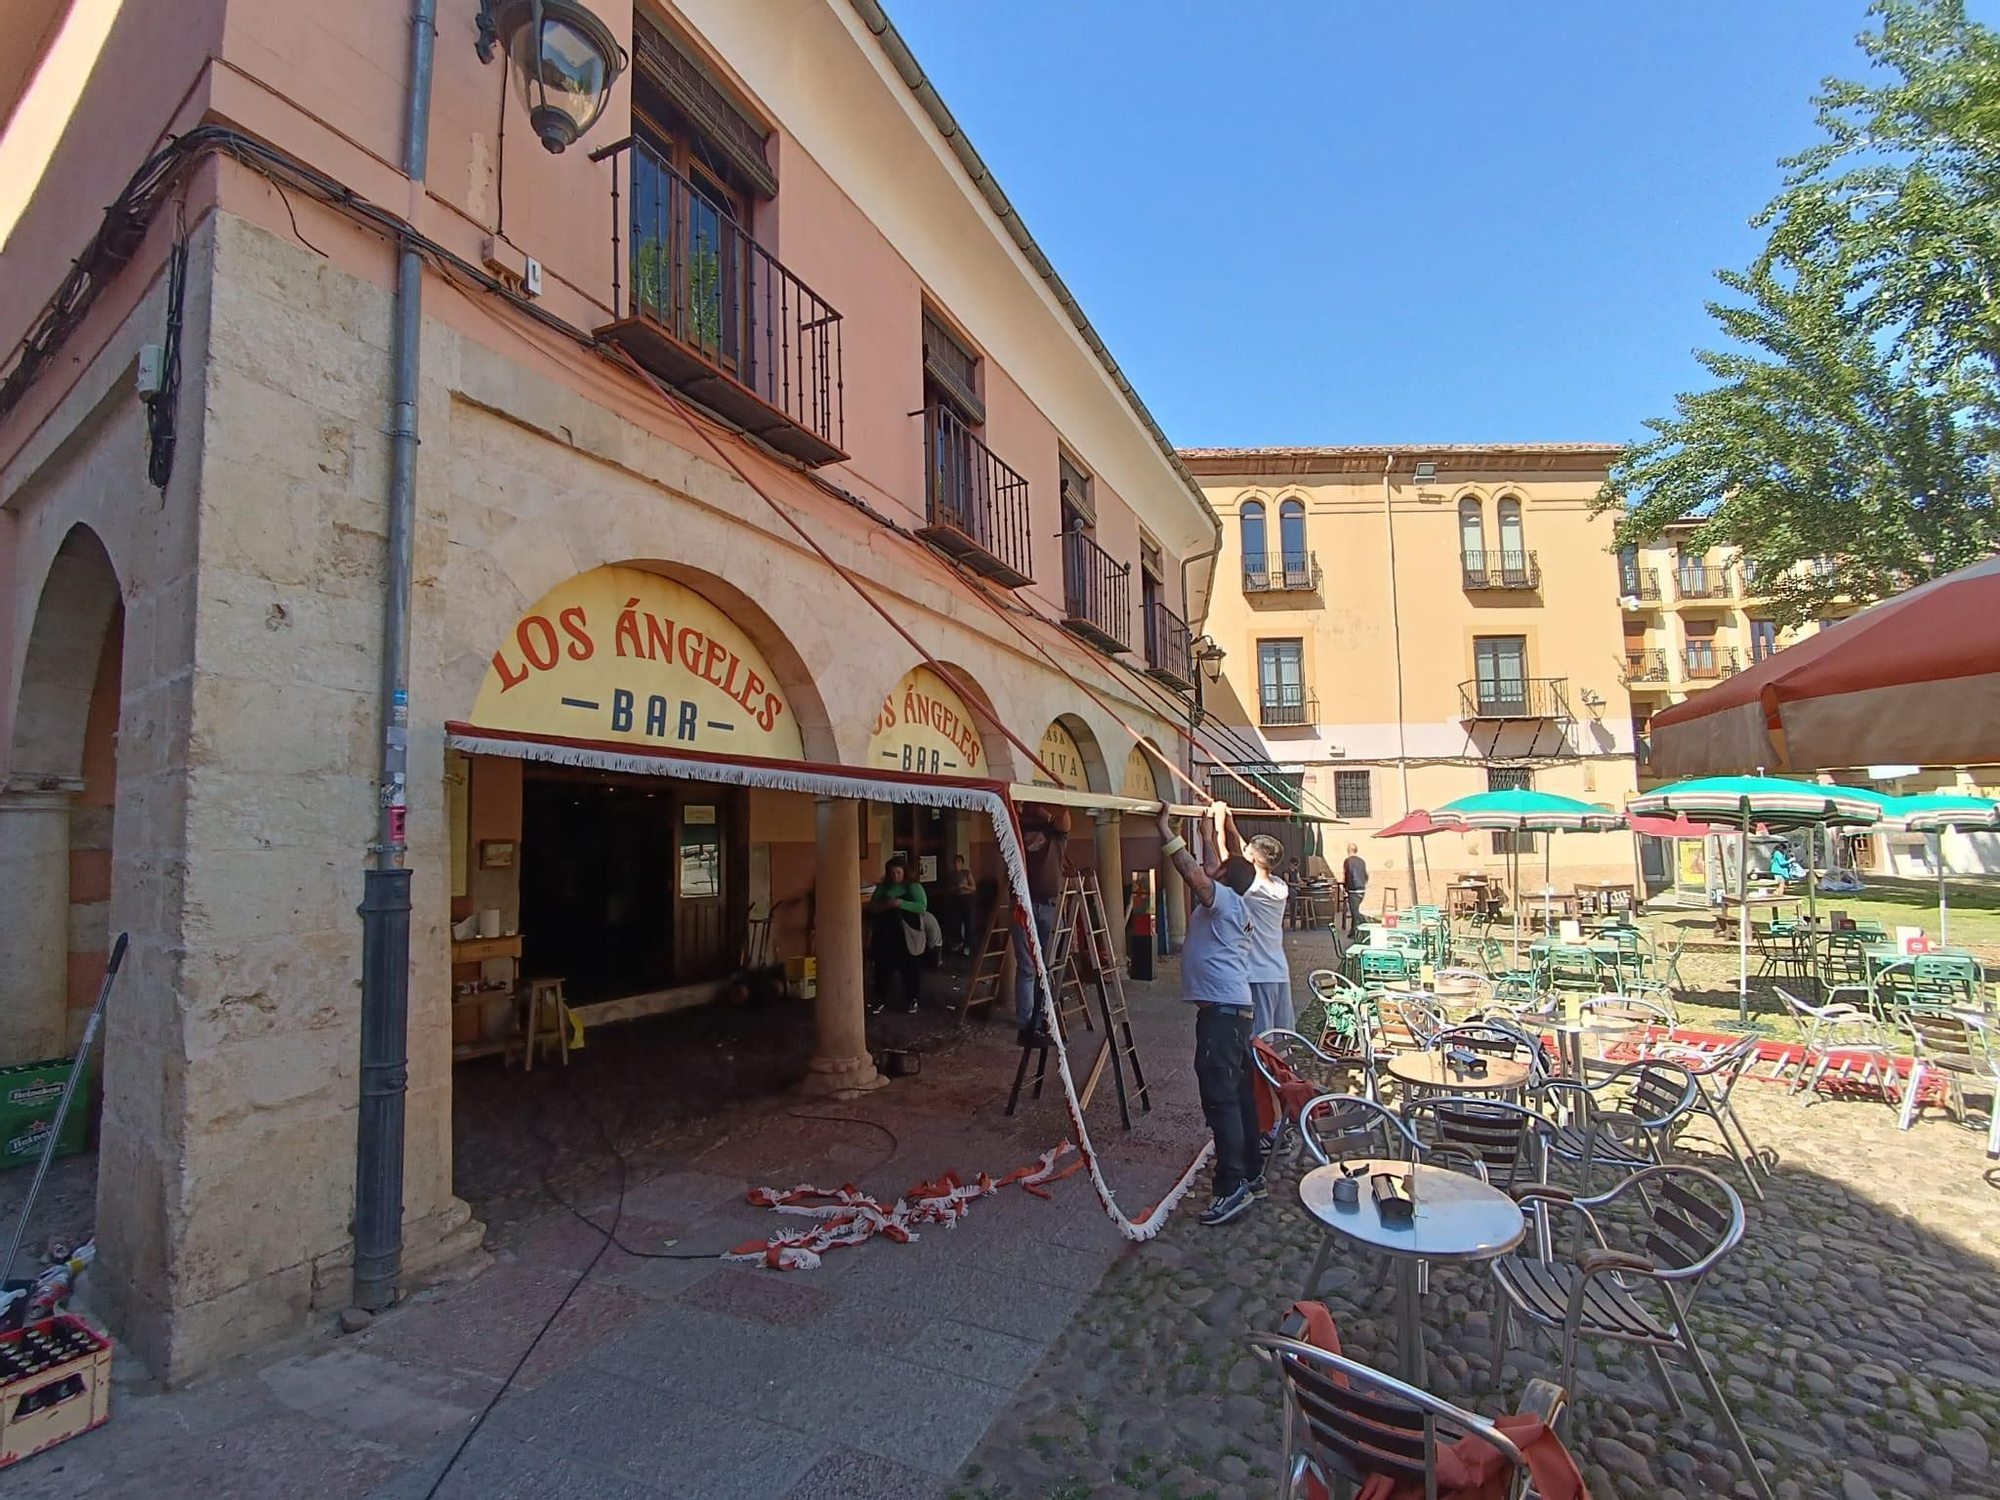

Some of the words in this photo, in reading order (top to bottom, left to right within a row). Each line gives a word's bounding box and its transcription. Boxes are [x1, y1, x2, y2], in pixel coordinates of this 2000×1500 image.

[491, 606, 594, 694] LOS
[615, 597, 783, 733] ÁNGELES
[611, 687, 698, 742] BAR
[904, 684, 980, 767] ÁNGELES
[1043, 729, 1065, 746] ASA
[902, 744, 940, 775] BAR
[1040, 749, 1078, 777] LIVA
